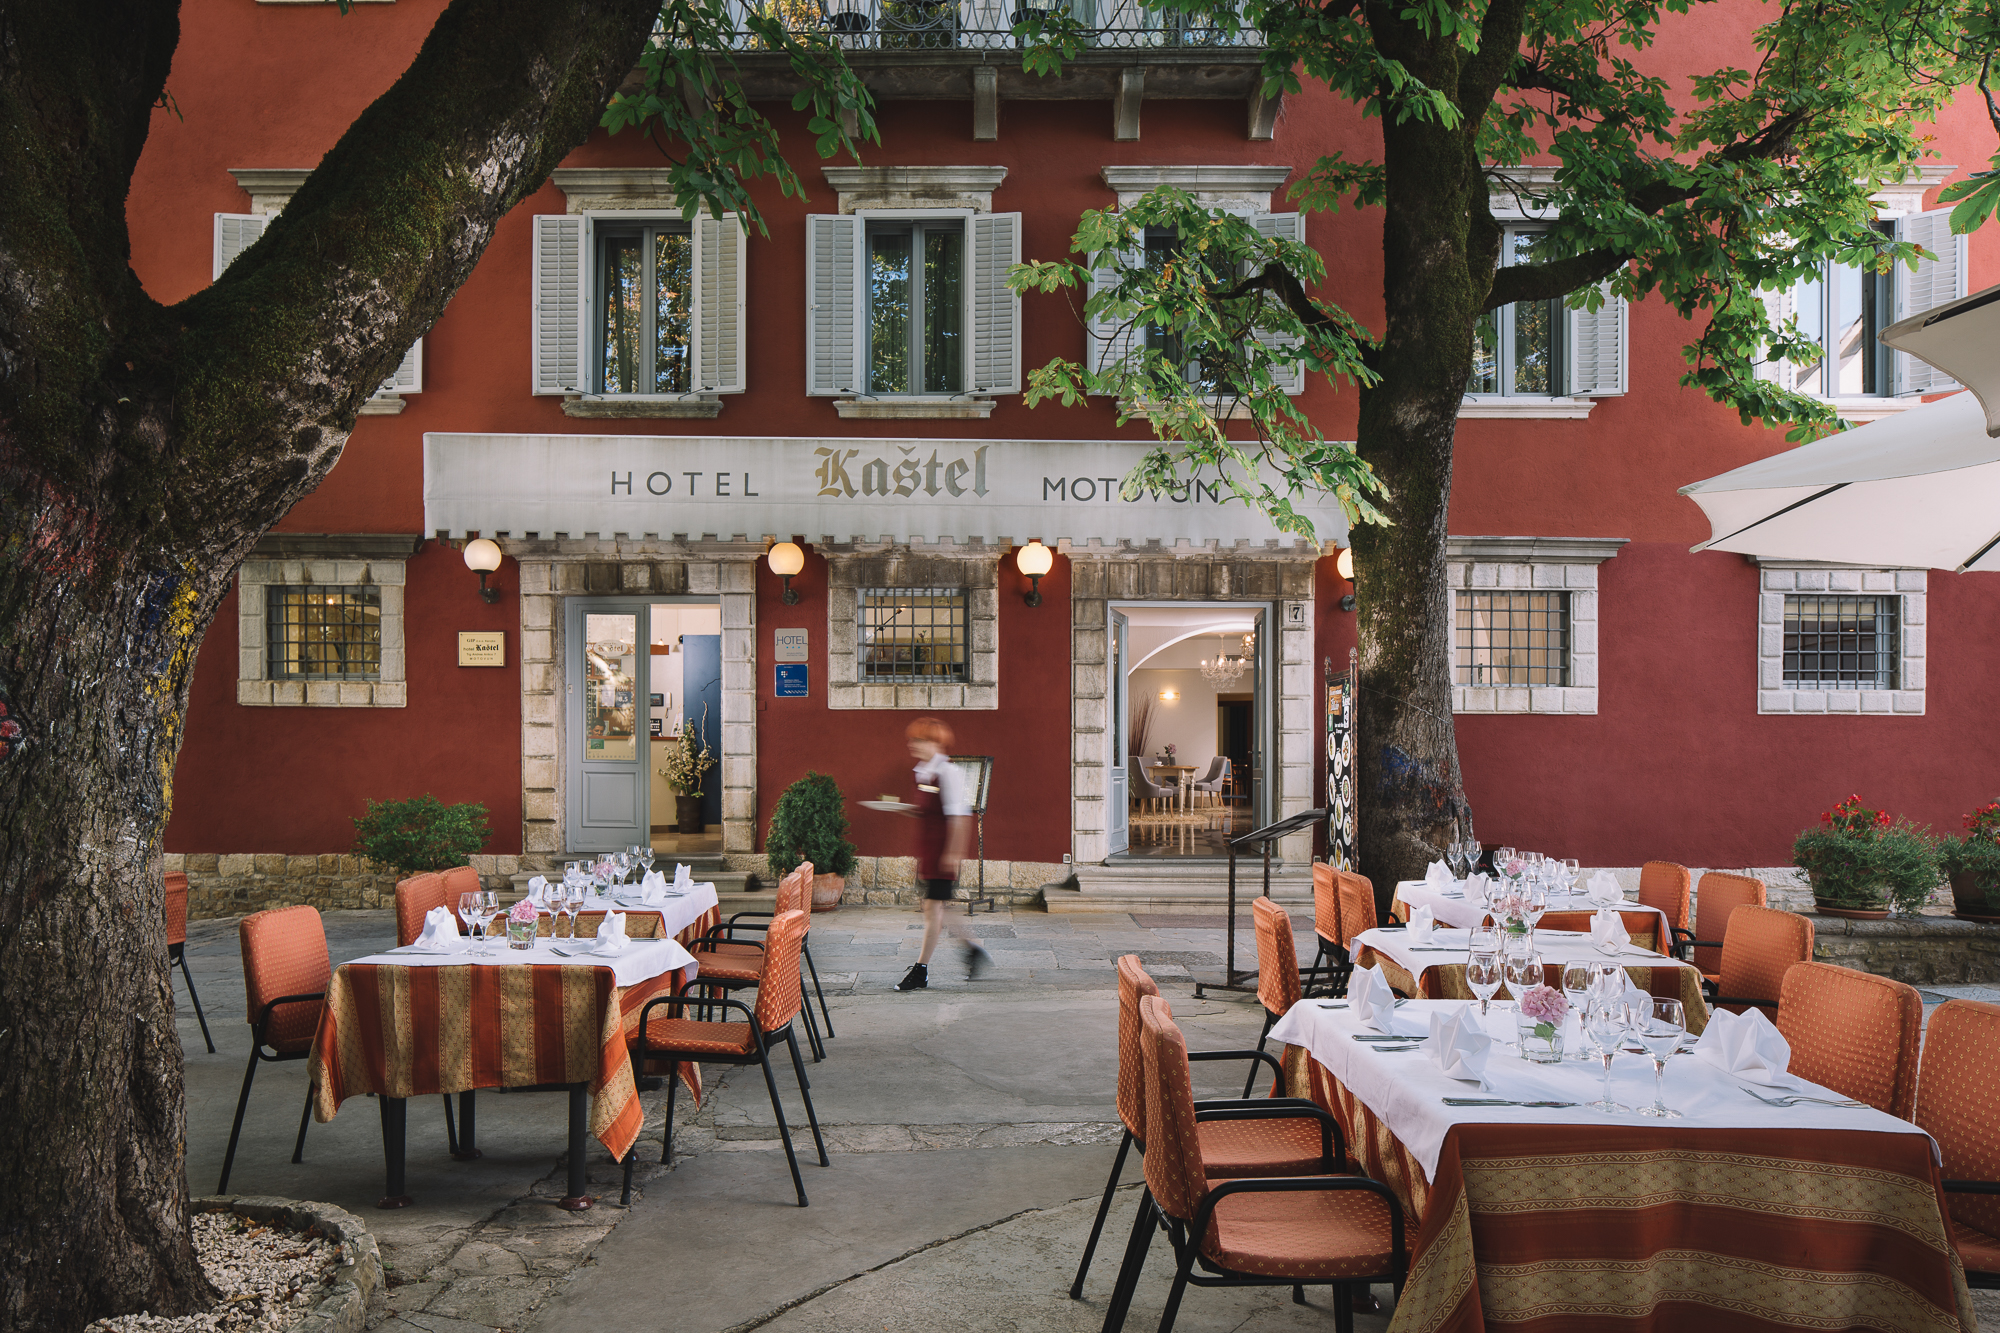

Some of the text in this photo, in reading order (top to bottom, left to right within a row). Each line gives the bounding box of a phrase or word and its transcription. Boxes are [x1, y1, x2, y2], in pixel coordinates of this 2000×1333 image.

[610, 471, 759, 497] HOTEL
[813, 444, 990, 499] Kaštel
[1292, 606, 1300, 620] 7
[776, 635, 807, 645] HOTEL
